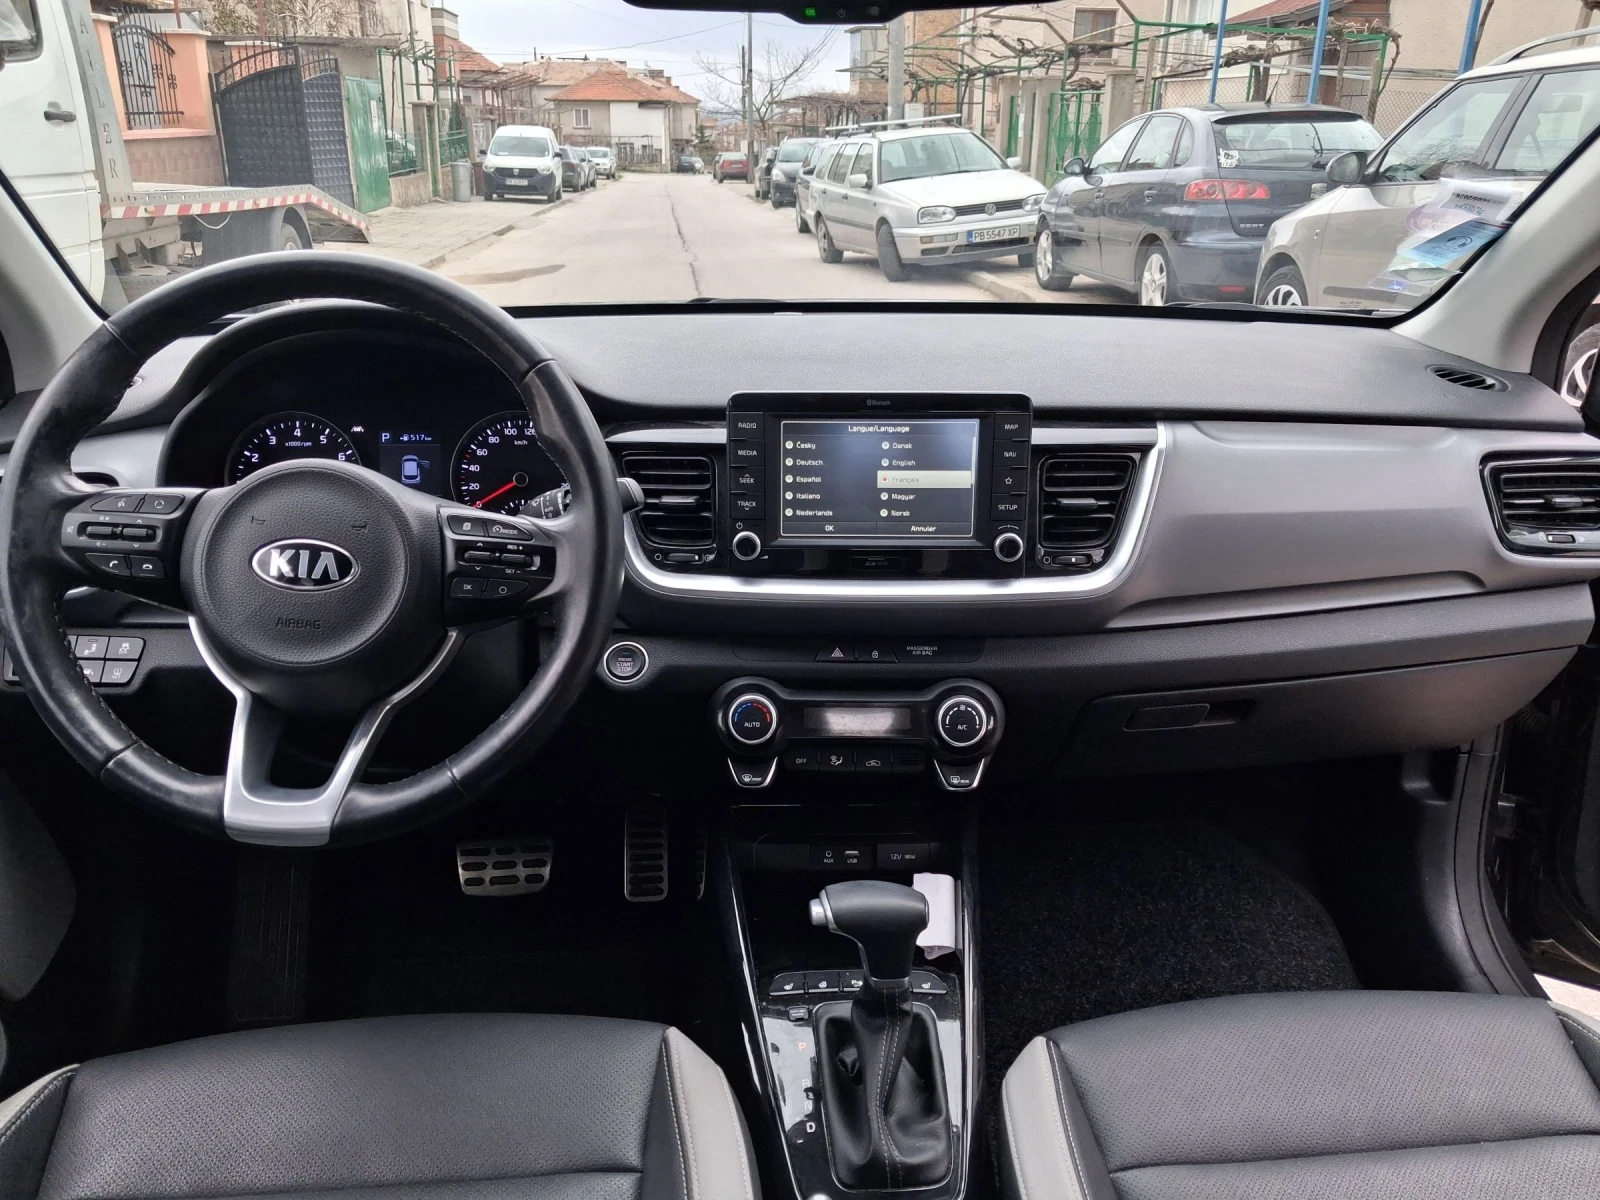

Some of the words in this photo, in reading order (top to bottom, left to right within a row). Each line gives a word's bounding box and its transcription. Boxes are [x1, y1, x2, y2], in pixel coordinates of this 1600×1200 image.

[974, 232, 985, 241] PB
[986, 229, 1006, 240] 5547
[1008, 227, 1018, 237] XP
[293, 428, 302, 437] 4
[848, 425, 910, 433] Langue/Language
[268, 436, 276, 445] 3
[320, 435, 327, 444] 5
[382, 432, 390, 443] P
[488, 436, 500, 444] 80
[338, 452, 346, 461] 6
[476, 448, 488, 456] 60
[251, 453, 259, 462] 2
[892, 459, 916, 467] English
[468, 464, 480, 472] 40
[796, 475, 822, 483] Español
[796, 492, 821, 500] Italiano
[891, 493, 916, 501] Magyar
[795, 509, 833, 517] Nederlands
[269, 548, 339, 581] KIA
[275, 617, 321, 630] AIRBAG
[798, 1042, 807, 1052] P
[806, 1121, 816, 1133] D
